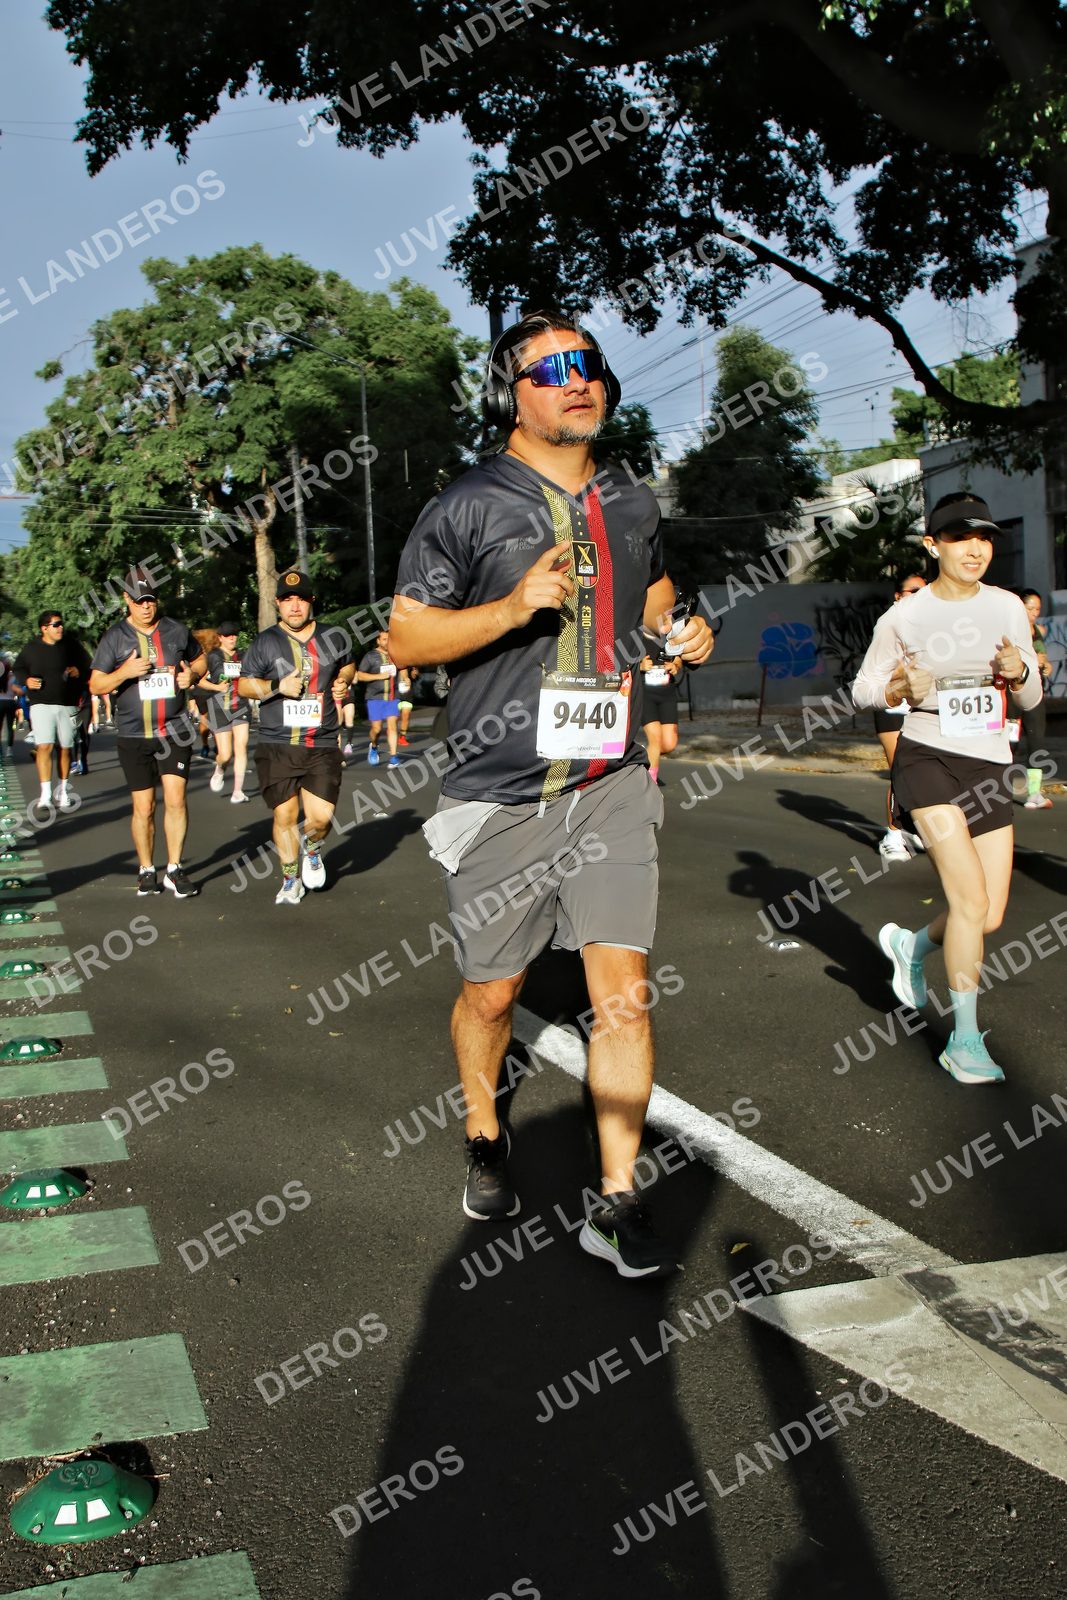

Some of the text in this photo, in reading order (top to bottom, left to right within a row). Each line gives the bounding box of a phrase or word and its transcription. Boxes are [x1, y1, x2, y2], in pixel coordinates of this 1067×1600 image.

[144, 677, 169, 689] 8501
[286, 704, 320, 716] 11874
[948, 694, 994, 717] 9613
[553, 701, 617, 730] 9440
